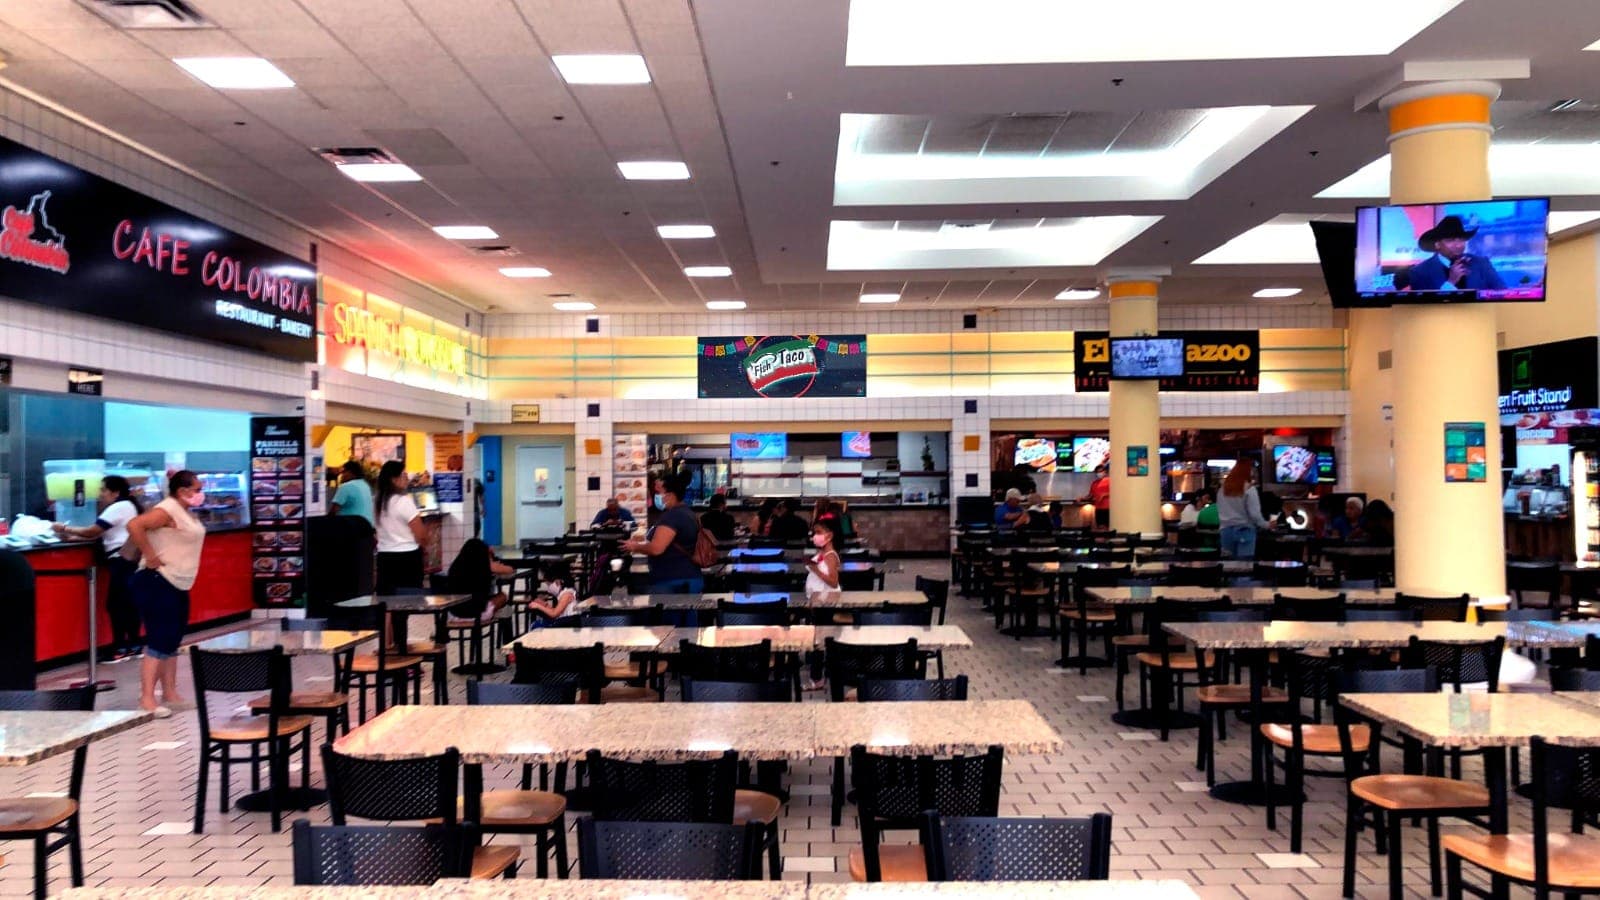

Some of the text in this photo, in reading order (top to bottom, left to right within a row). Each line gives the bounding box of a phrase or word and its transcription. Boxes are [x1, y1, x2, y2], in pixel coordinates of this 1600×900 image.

[112, 219, 191, 276] CAFE
[202, 251, 312, 316] COLOMBIA
[216, 299, 276, 330] RESTAURANT
[754, 349, 805, 377] Fish Taco
[1082, 338, 1251, 363] El azoo
[1511, 389, 1537, 406] Fruit
[1537, 386, 1572, 405] Stand
